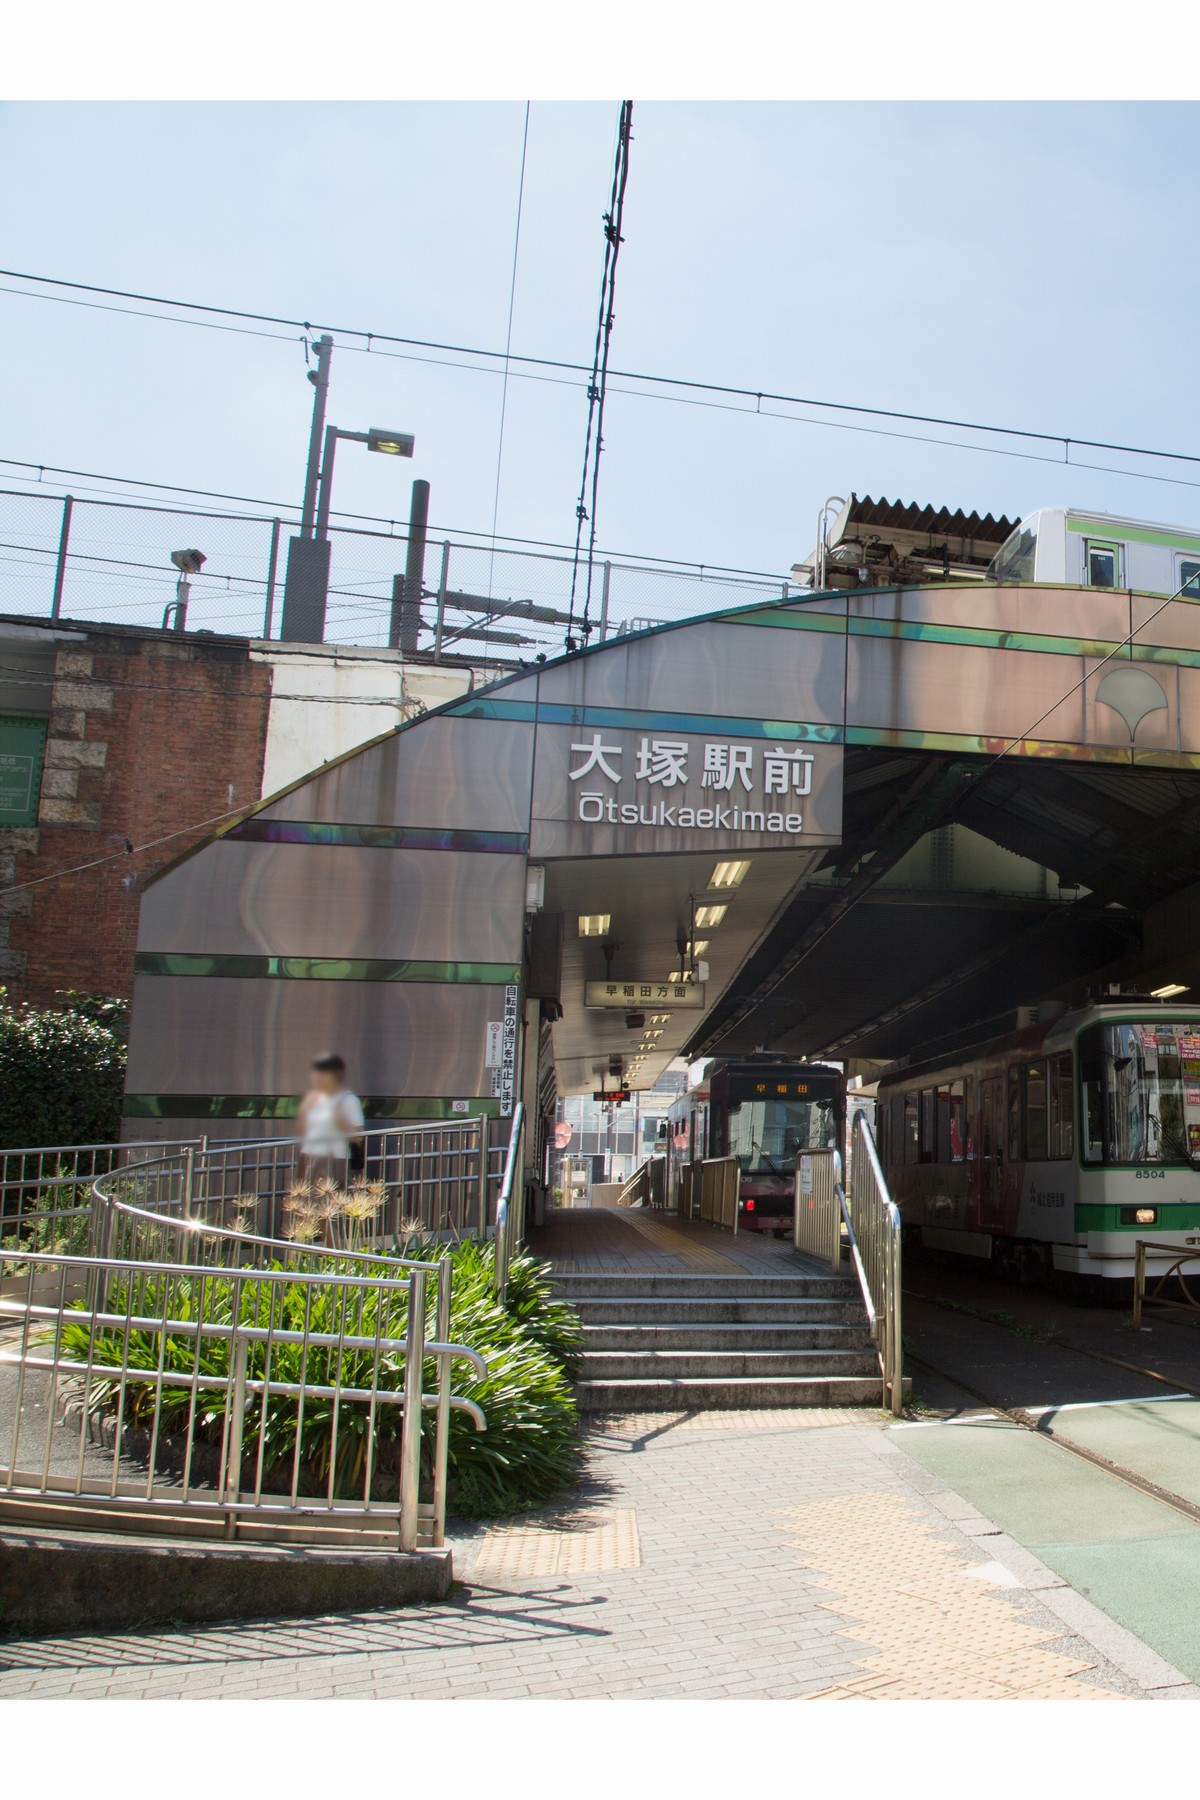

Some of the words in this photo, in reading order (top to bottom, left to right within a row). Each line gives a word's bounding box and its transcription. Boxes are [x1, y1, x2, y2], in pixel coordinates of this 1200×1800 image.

[568, 733, 815, 796] 大塚駅前
[578, 791, 803, 833] Ōtsukaekimae
[605, 984, 686, 998] 早稲田方面
[756, 1084, 808, 1094] 早稲田
[1135, 1170, 1165, 1179] 8504
